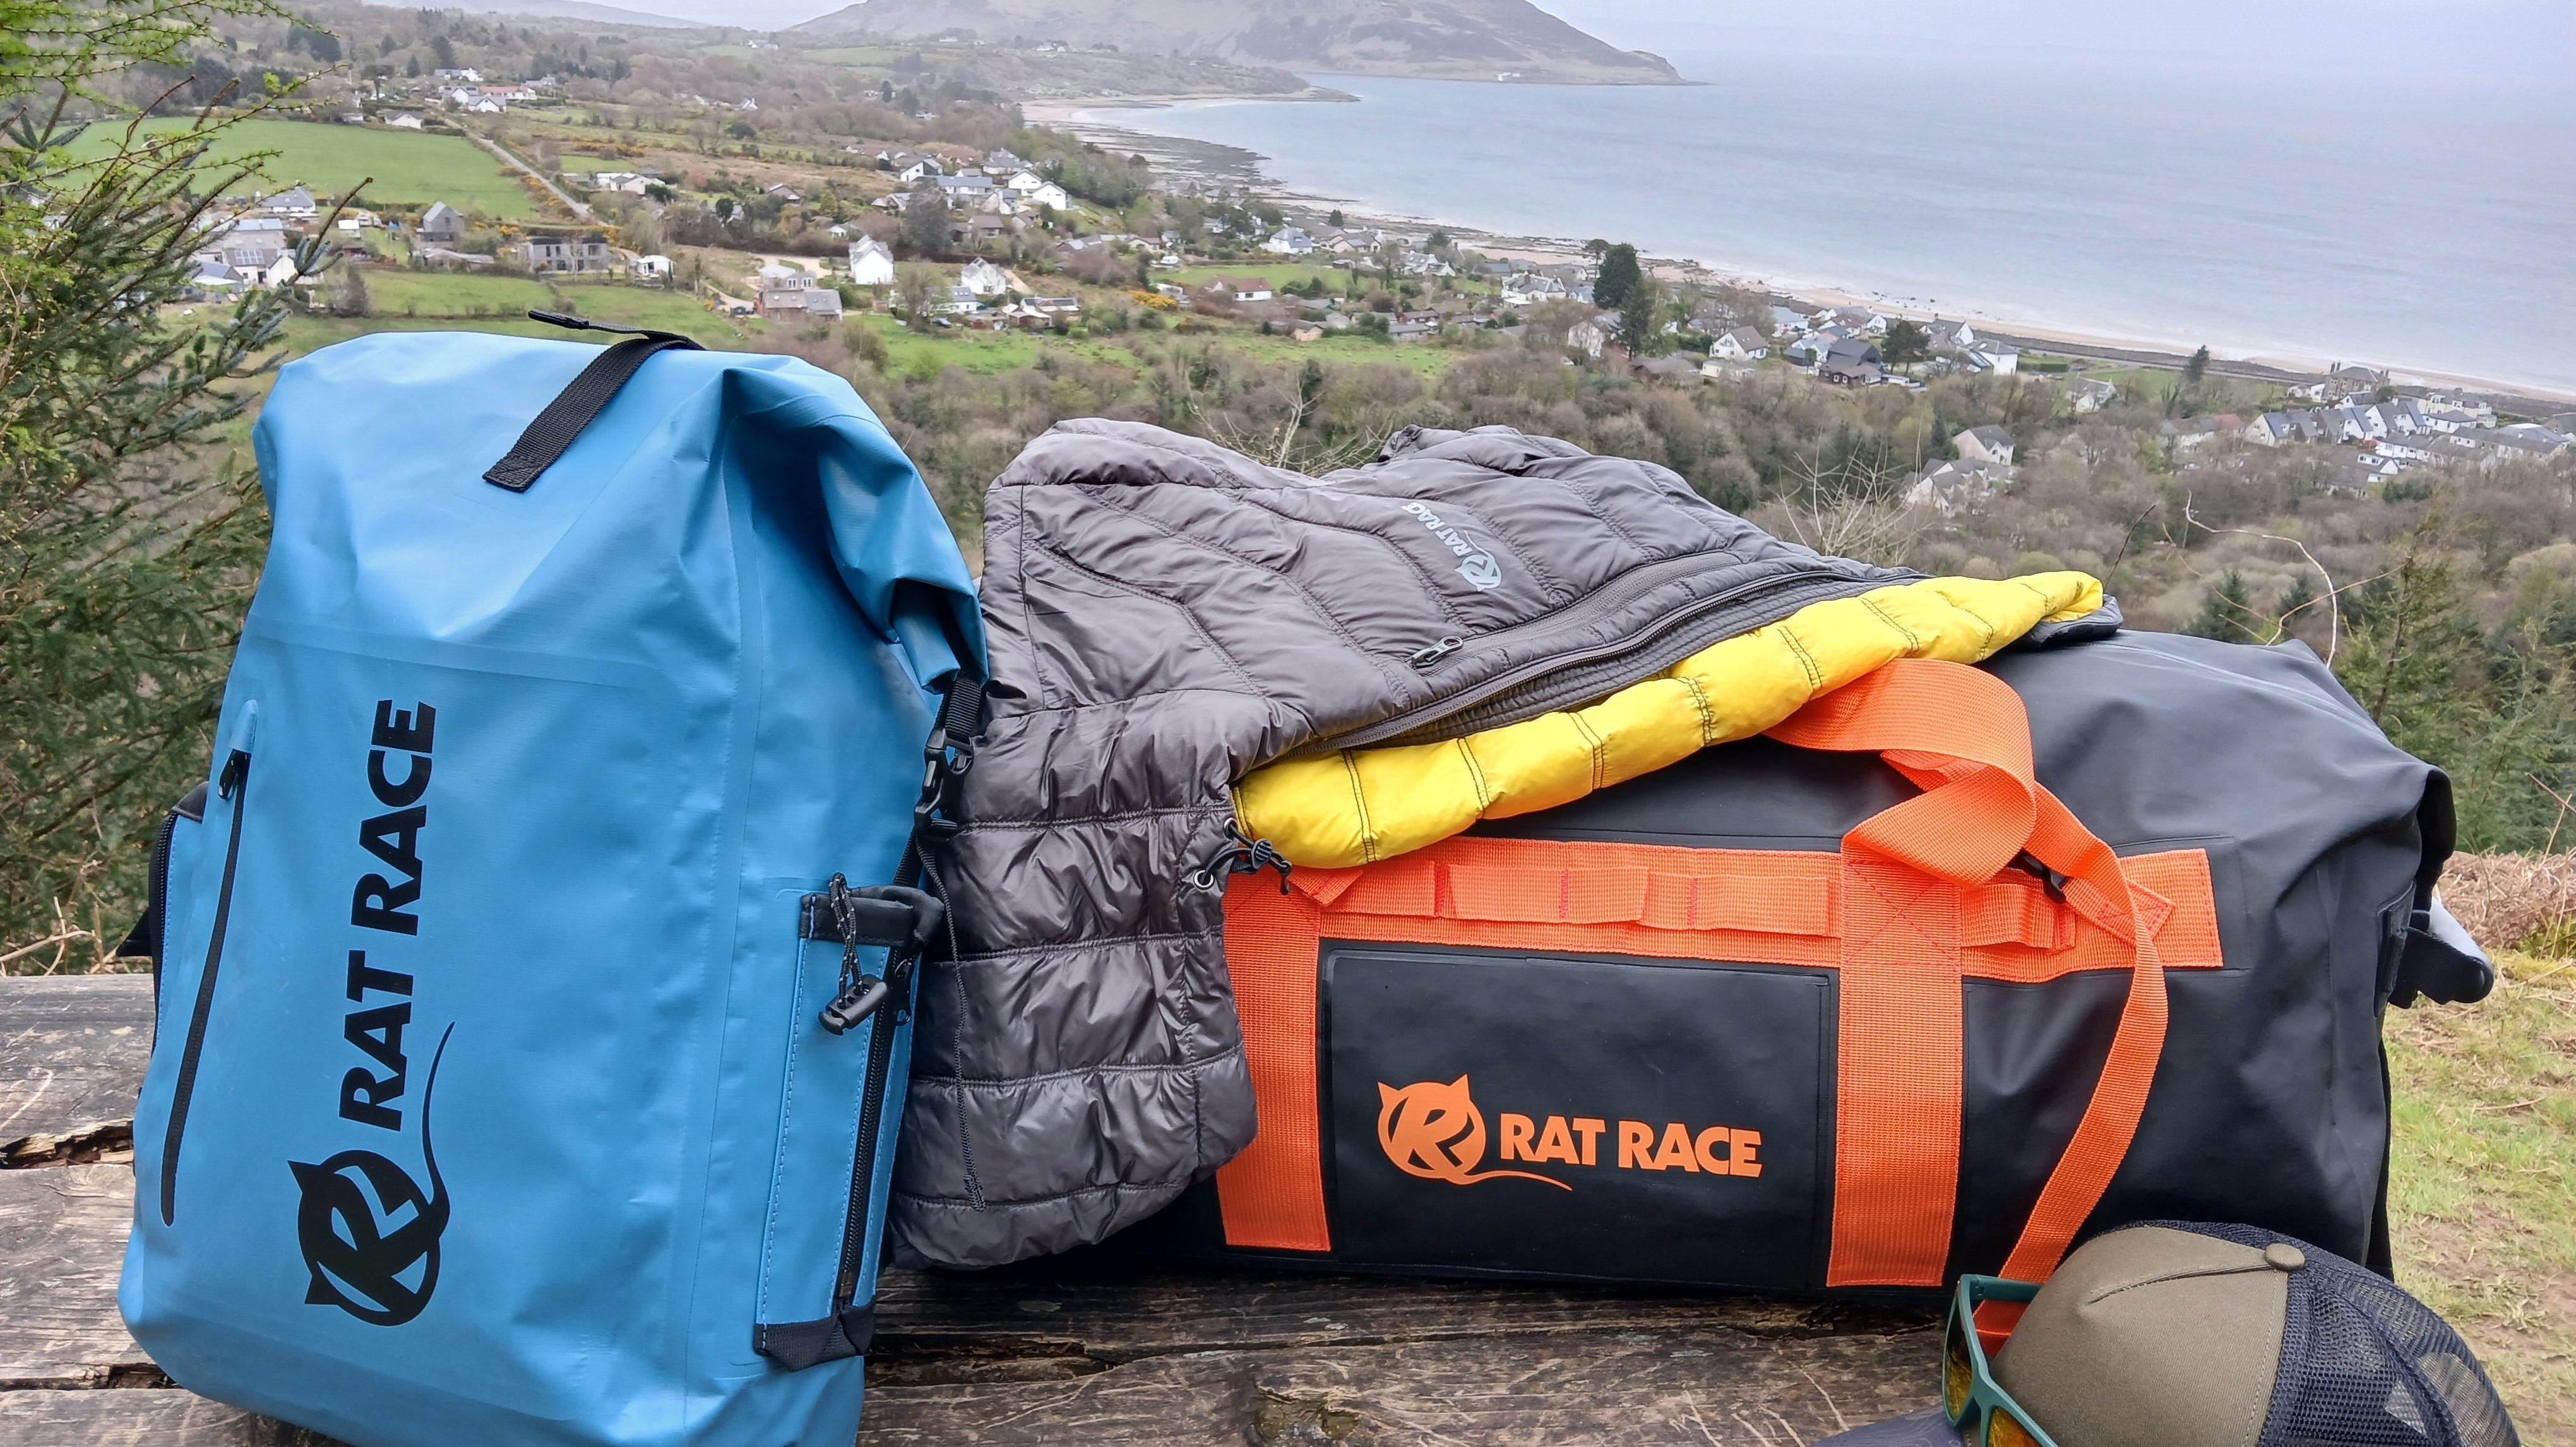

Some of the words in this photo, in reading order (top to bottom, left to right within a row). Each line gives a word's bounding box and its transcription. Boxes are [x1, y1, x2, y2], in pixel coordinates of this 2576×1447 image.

[1434, 527, 1473, 556] RAT
[351, 700, 436, 936] RACE
[339, 950, 414, 1131] RAT
[1501, 1113, 1606, 1166] RAT
[1619, 1121, 1762, 1177] RACE
